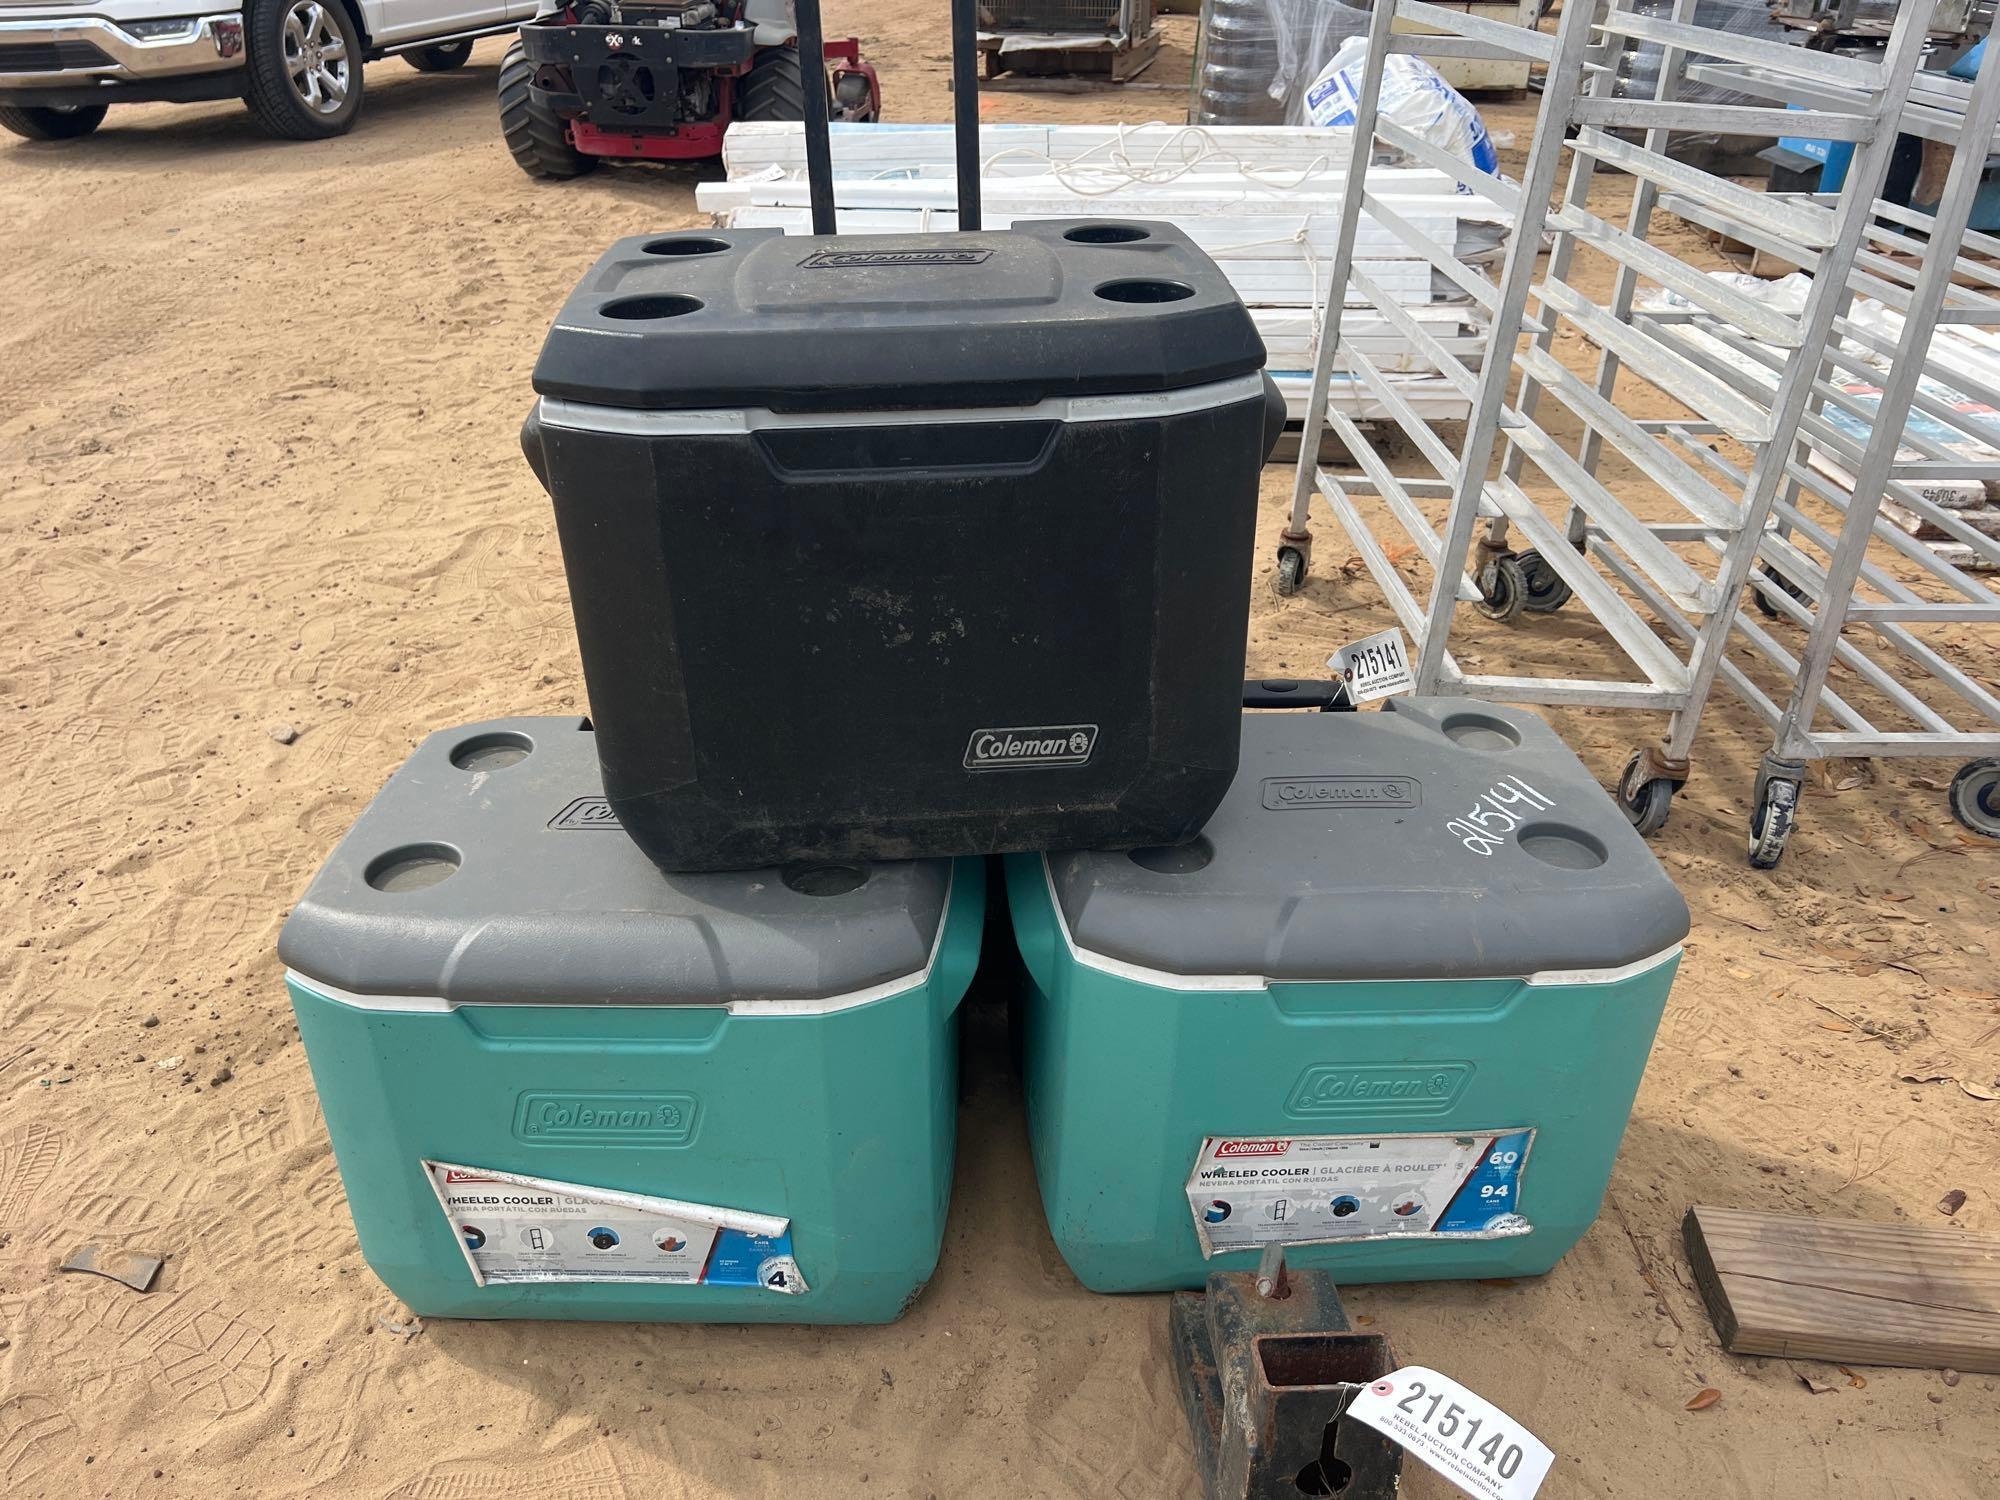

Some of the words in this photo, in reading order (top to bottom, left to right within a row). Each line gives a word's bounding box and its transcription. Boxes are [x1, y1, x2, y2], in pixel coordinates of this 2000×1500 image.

[832, 251, 946, 263] Coleman
[1351, 641, 1402, 679] 215141
[975, 734, 1067, 759] Coleman
[1278, 784, 1379, 801] Coleman
[1446, 774, 1557, 857] 215141
[1314, 1074, 1423, 1099] Coleman
[539, 1102, 652, 1128] Coleman
[1220, 1141, 1275, 1154] Coleman
[1489, 1151, 1519, 1165] 60
[1261, 1167, 1309, 1177] COOLER
[1382, 1162, 1392, 1173] À
[1199, 1179, 1235, 1188] NEVERA
[1237, 1177, 1280, 1186] PORTÁTIL
[1282, 1176, 1302, 1184] CON
[1303, 1175, 1339, 1183] RUEDAS
[1480, 1184, 1509, 1198] 94
[503, 1196, 554, 1205] COOLER
[481, 1205, 526, 1213] PORTÁTIL
[550, 1206, 587, 1214] RUEDAS
[767, 1270, 788, 1288] 4
[1397, 1381, 1524, 1480] 215140
[1393, 1413, 1421, 1434] REBEL
[1421, 1432, 1460, 1460] AUCTION
[1460, 1458, 1503, 1490] COMPANY
